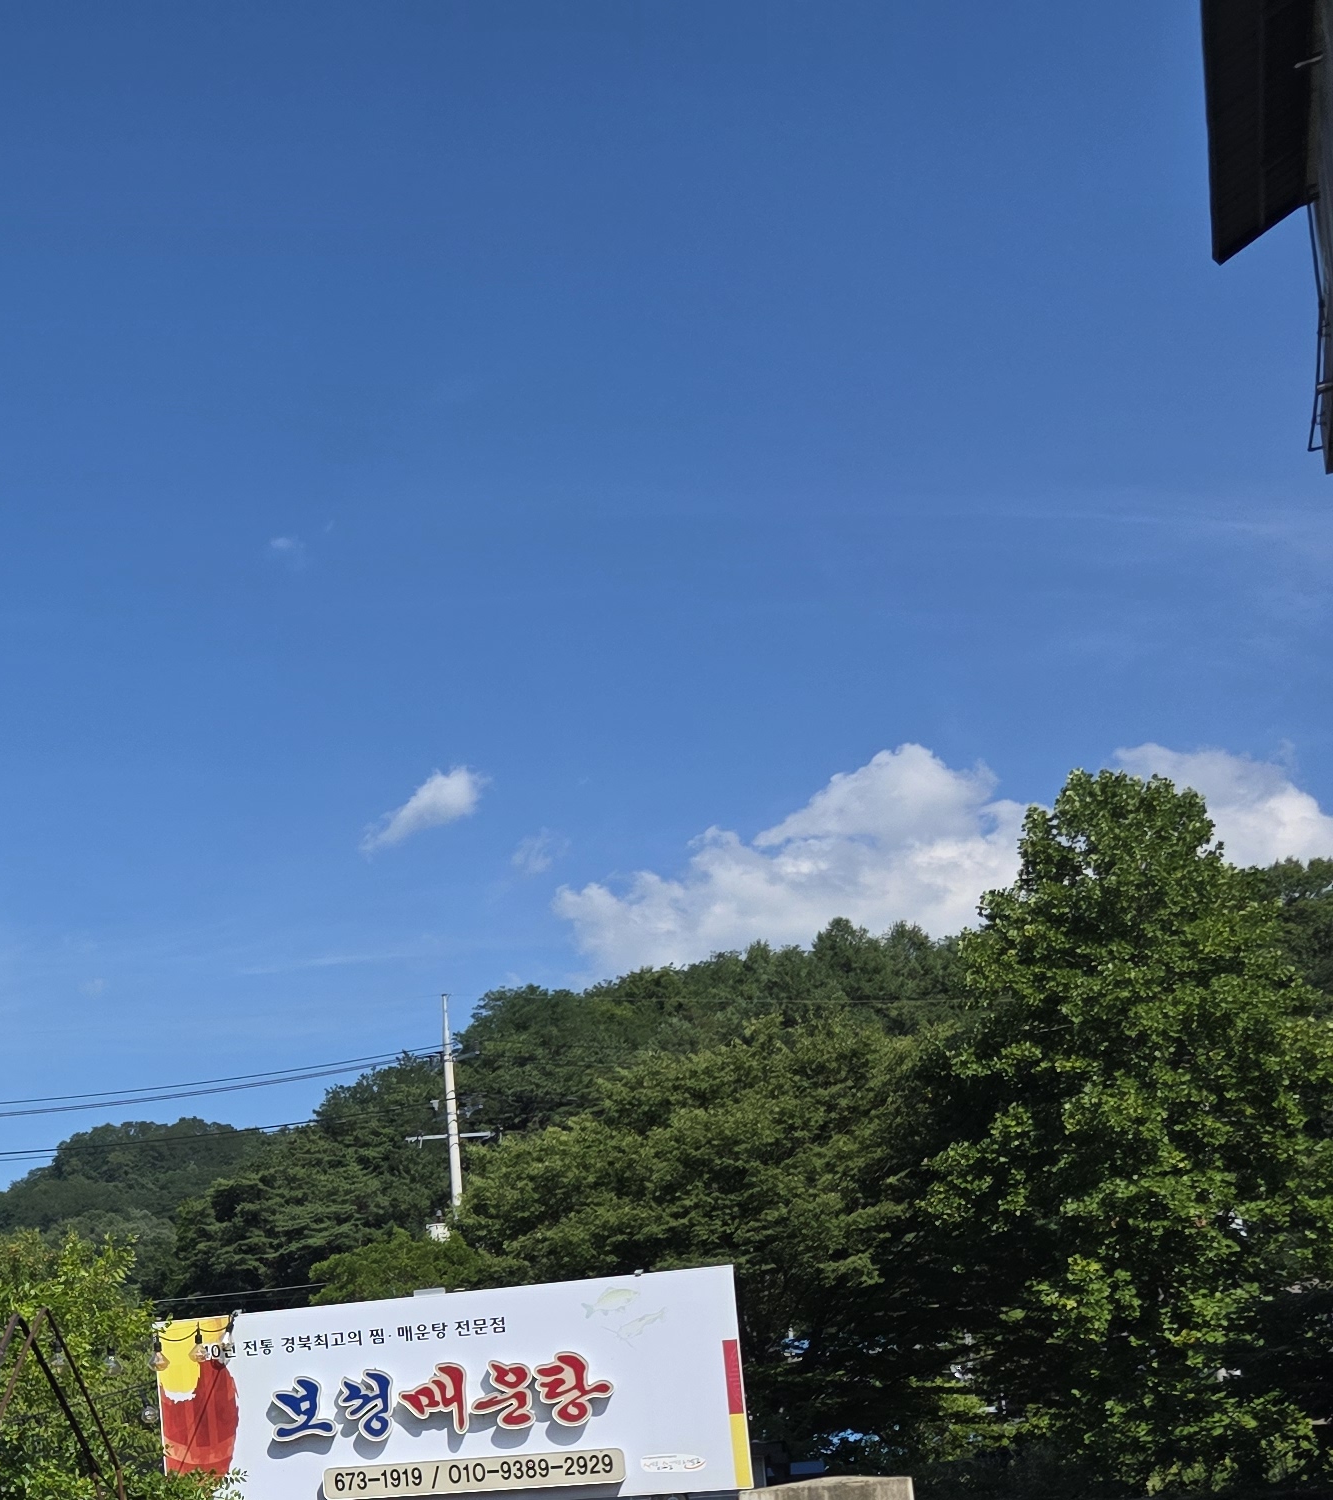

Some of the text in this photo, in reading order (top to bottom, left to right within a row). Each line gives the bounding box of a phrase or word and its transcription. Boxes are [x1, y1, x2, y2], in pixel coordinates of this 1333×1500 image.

[242, 1339, 275, 1358] 전통
[281, 1329, 364, 1353] 경북최고의
[454, 1316, 507, 1338] 전문점
[273, 1351, 615, 1441] 보성매운탕
[334, 1469, 423, 1492] 673-1919
[432, 1465, 440, 1490] /
[448, 1453, 614, 1484] 010-9389-2929
